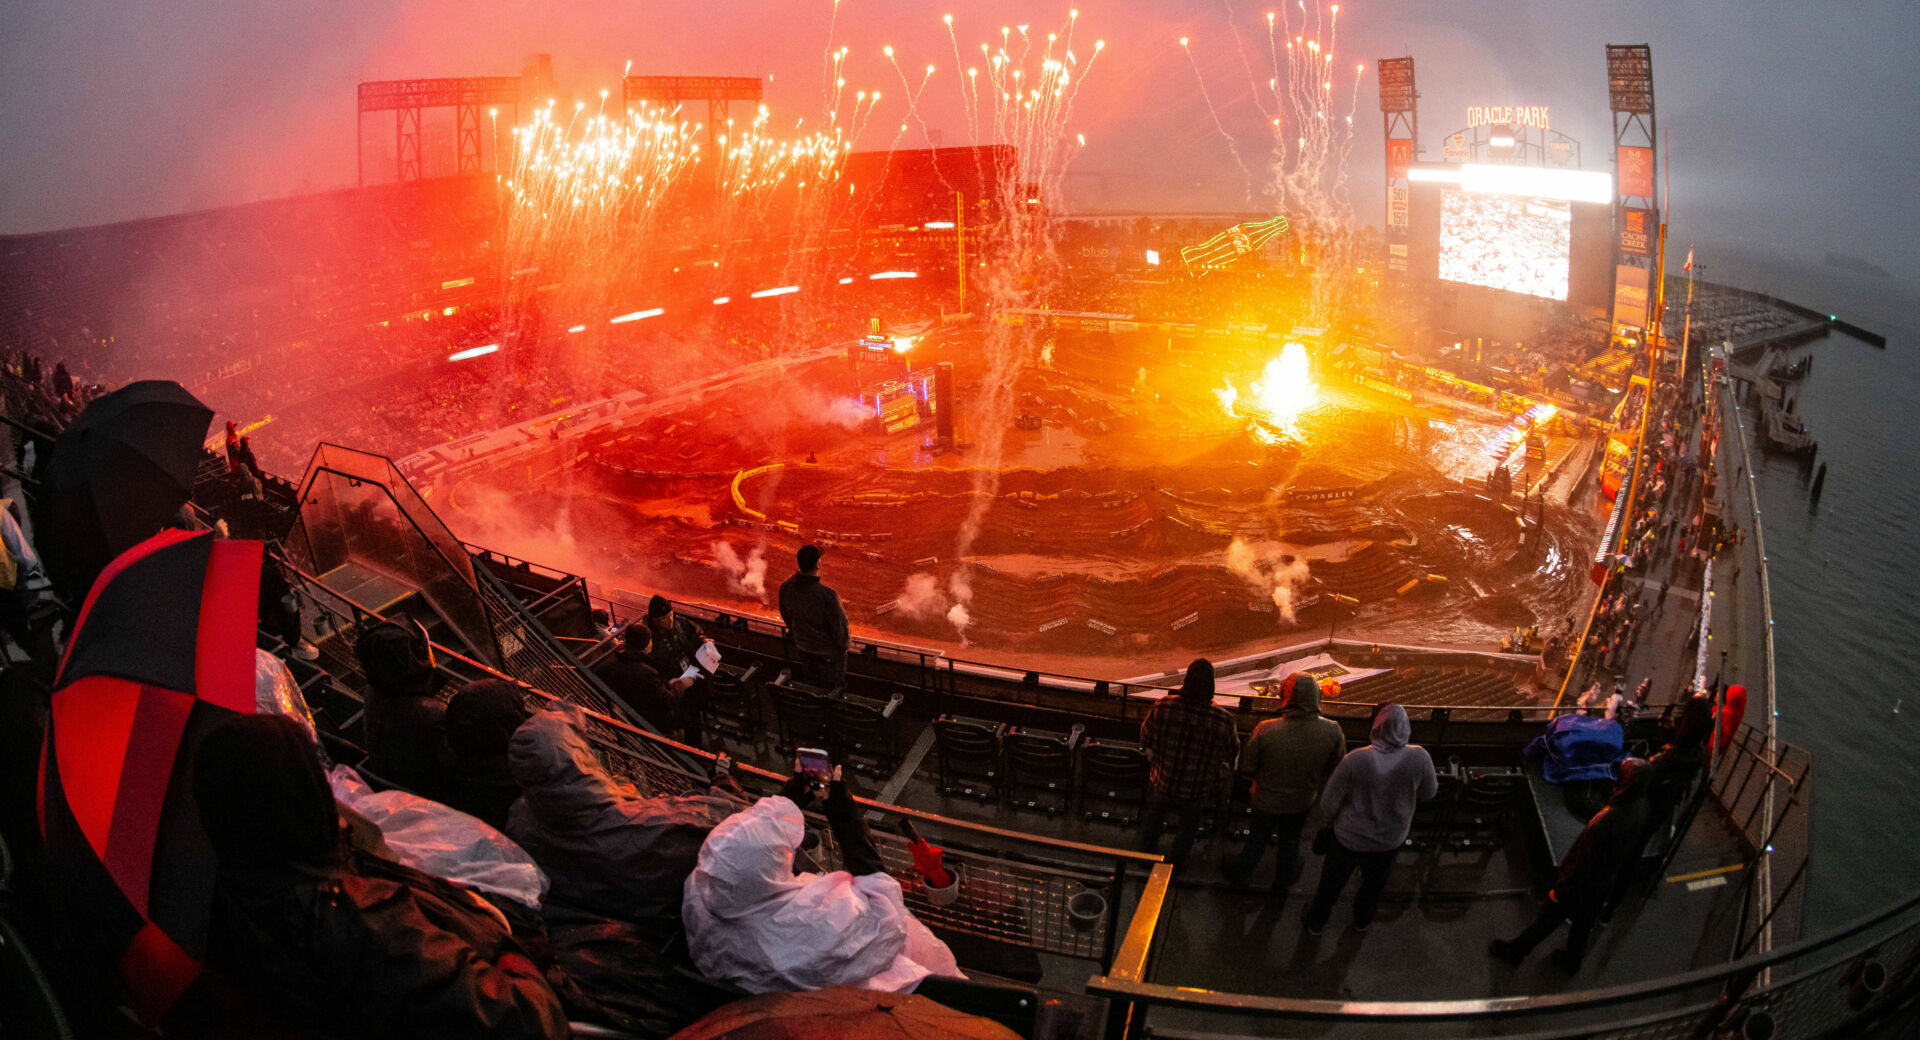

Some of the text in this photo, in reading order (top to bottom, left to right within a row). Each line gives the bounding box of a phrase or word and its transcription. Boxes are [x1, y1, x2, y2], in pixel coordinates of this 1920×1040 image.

[1467, 106, 1550, 130] ORACLE PARK
[1393, 188, 1407, 201] 501
[1393, 212, 1406, 225] 150
[859, 351, 889, 363] FINISH
